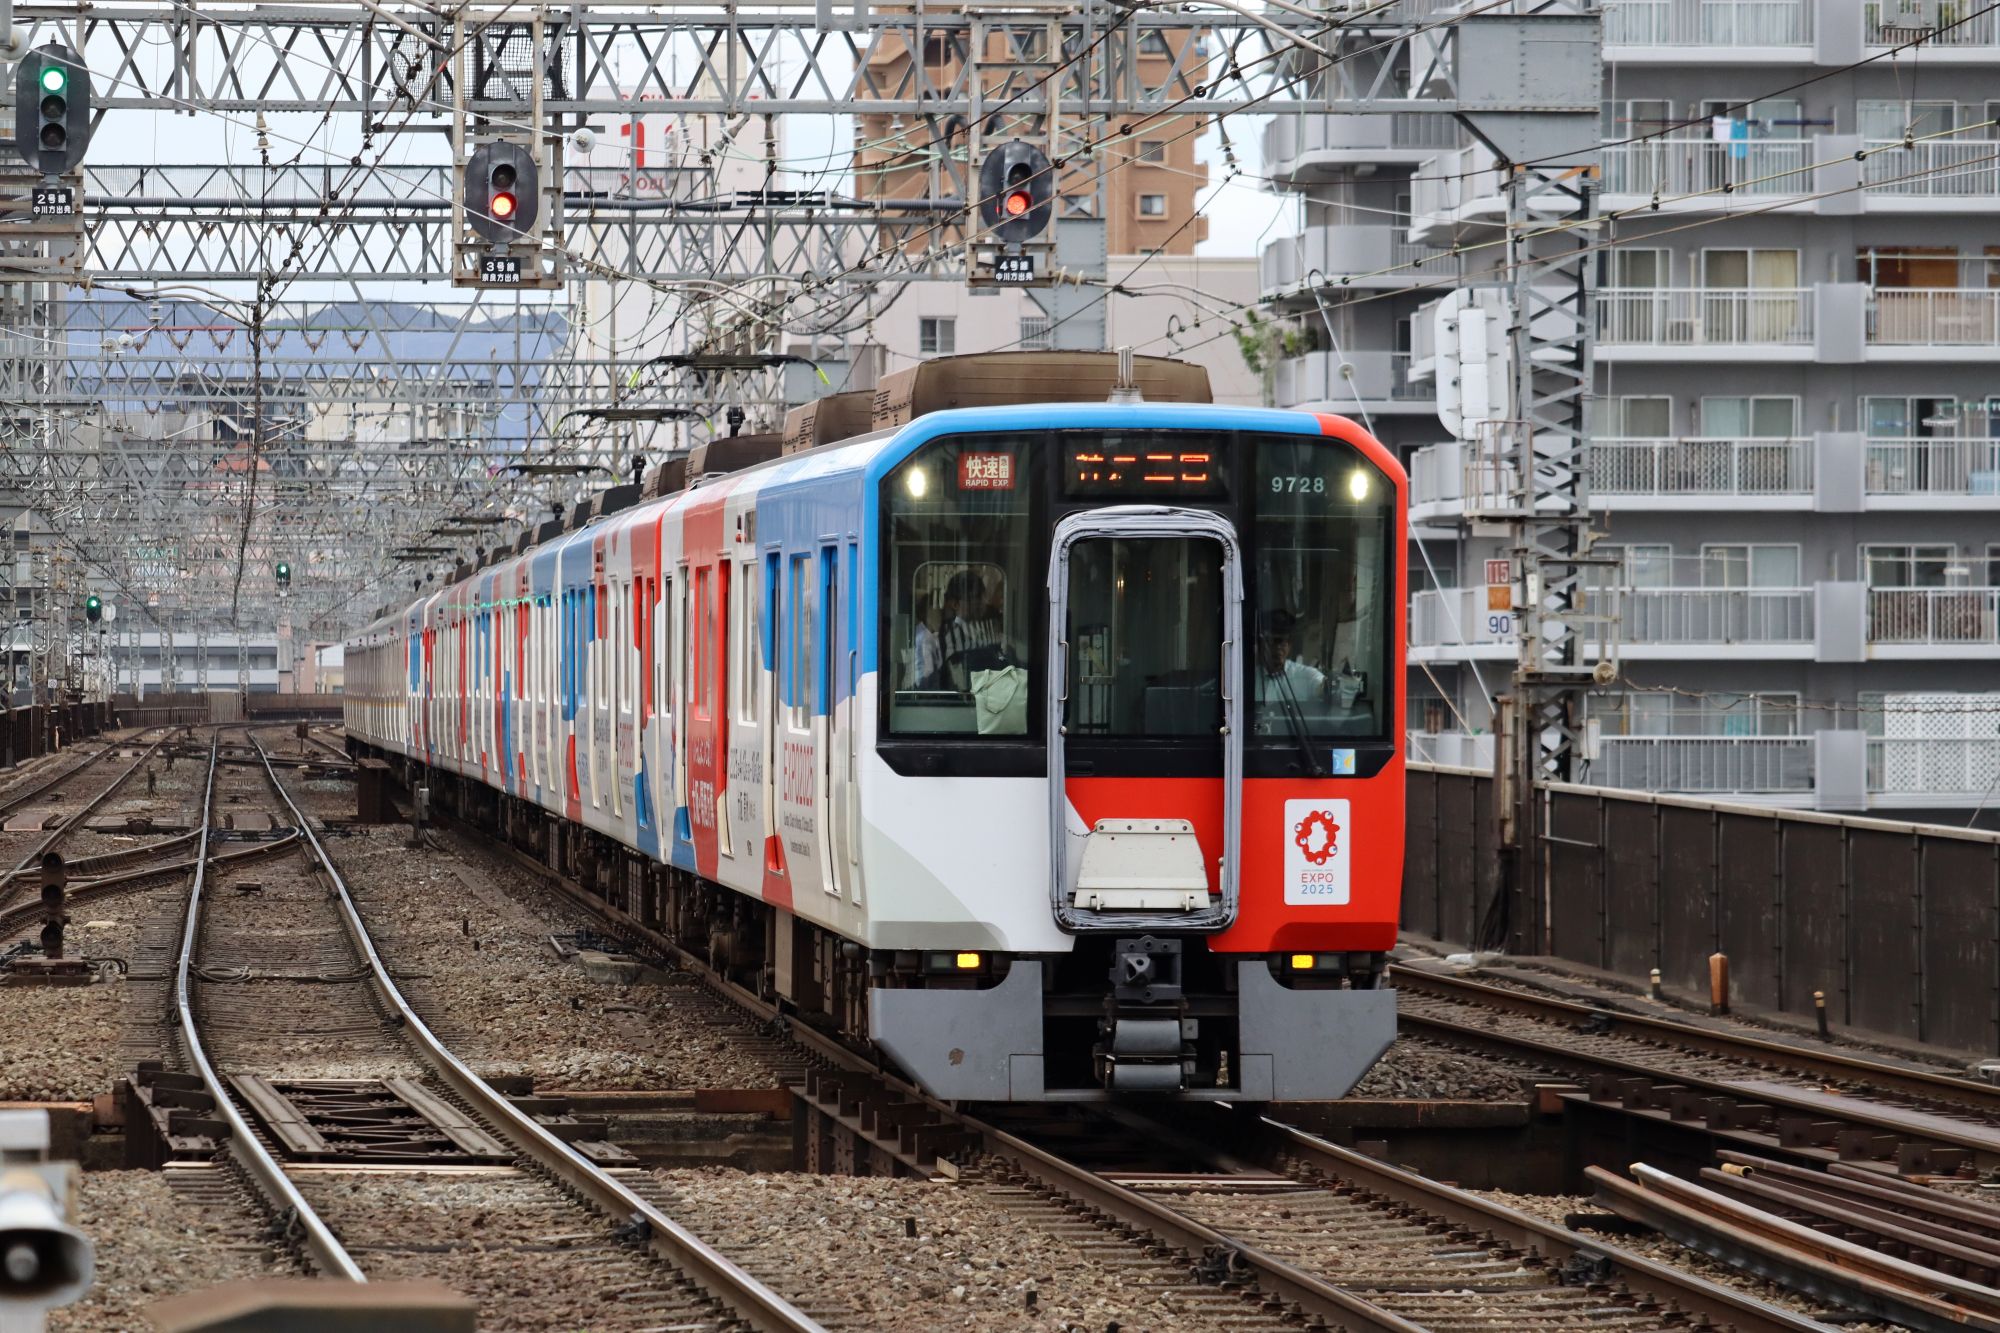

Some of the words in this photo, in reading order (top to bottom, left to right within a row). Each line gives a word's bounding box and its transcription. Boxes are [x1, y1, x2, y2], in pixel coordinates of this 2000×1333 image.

[37, 194, 67, 205] 2号線
[33, 205, 71, 215] 中川方出発
[486, 261, 515, 272] 3号線
[999, 260, 1029, 271] 4号線
[481, 273, 519, 282] 奈良方出発
[995, 271, 1033, 281] 中川方出発
[965, 479, 989, 487] RAPID
[992, 479, 1009, 487] EXP.
[1271, 476, 1324, 493] 9728
[1487, 562, 1509, 583] 115
[1488, 615, 1510, 634] 90
[1301, 872, 1334, 883] EXPO
[1301, 884, 1334, 895] 2025
